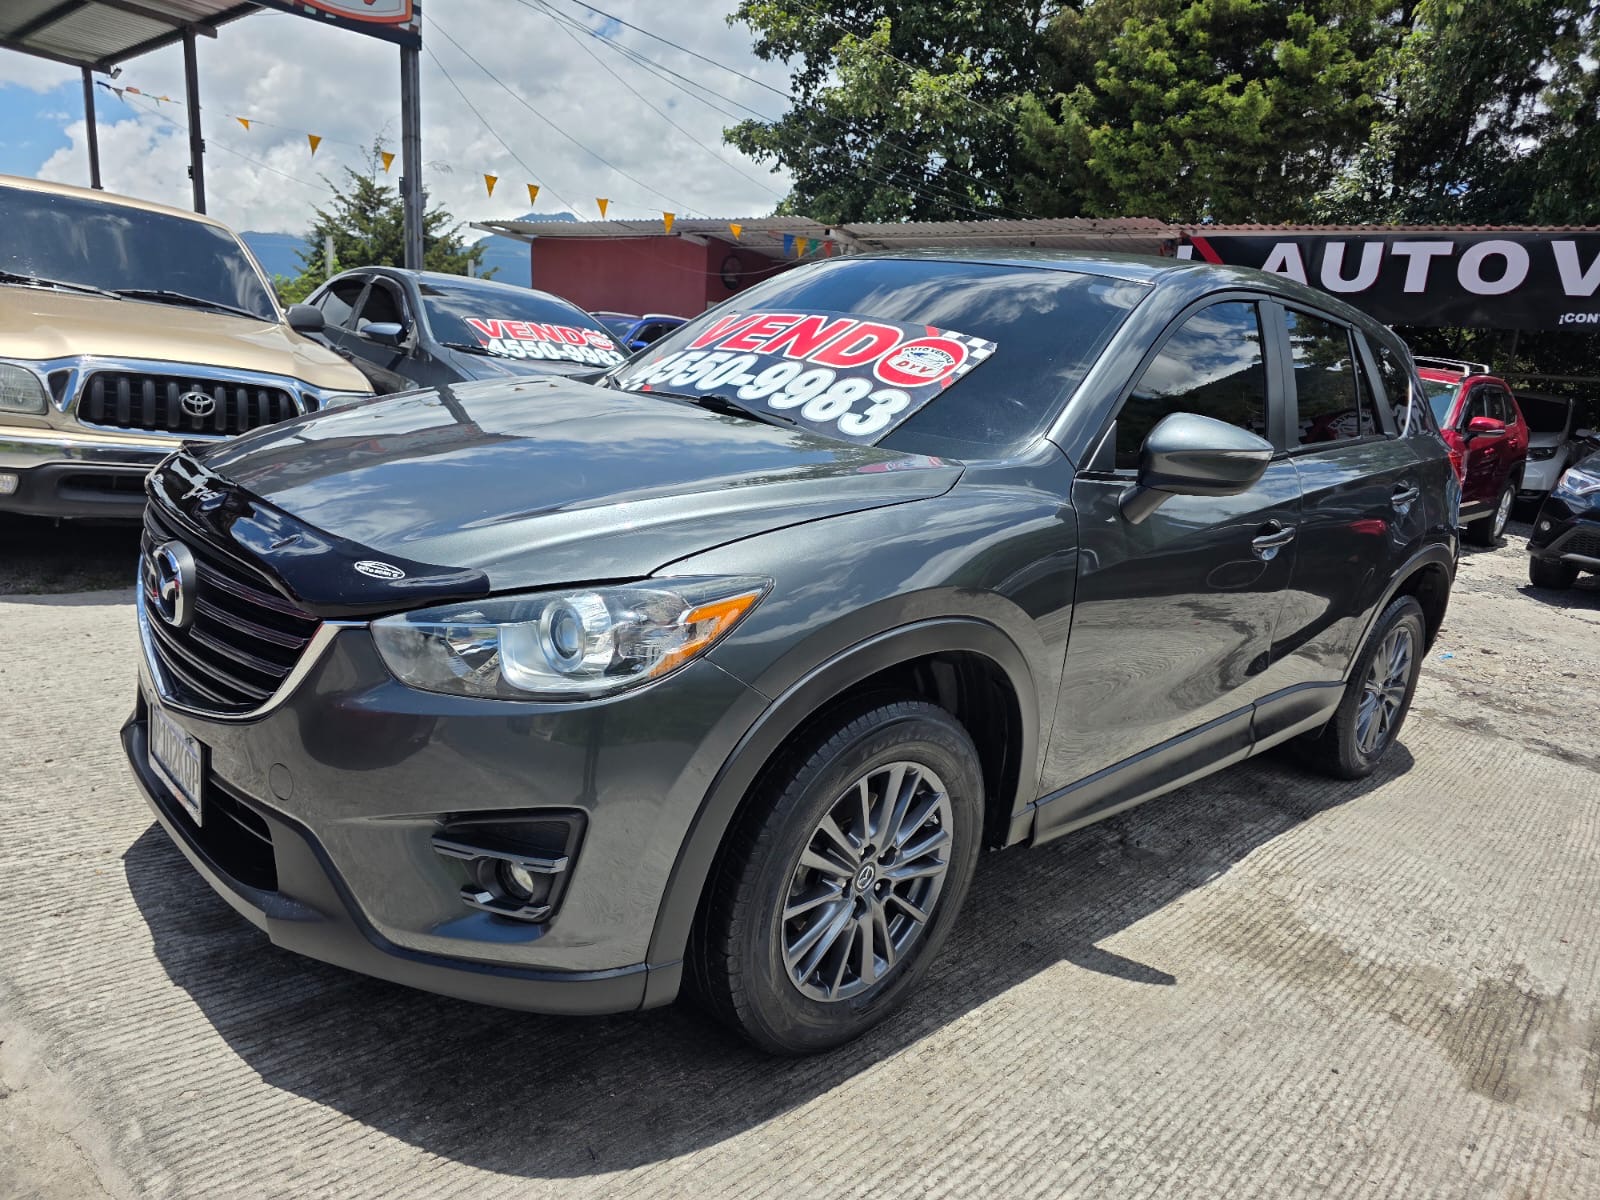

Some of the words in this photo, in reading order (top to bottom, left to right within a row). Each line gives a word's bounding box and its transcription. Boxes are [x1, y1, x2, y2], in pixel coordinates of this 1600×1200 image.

[1261, 239, 1531, 296] AUTO
[1559, 312, 1600, 325] ¡CON
[624, 350, 912, 436] 4550-9983
